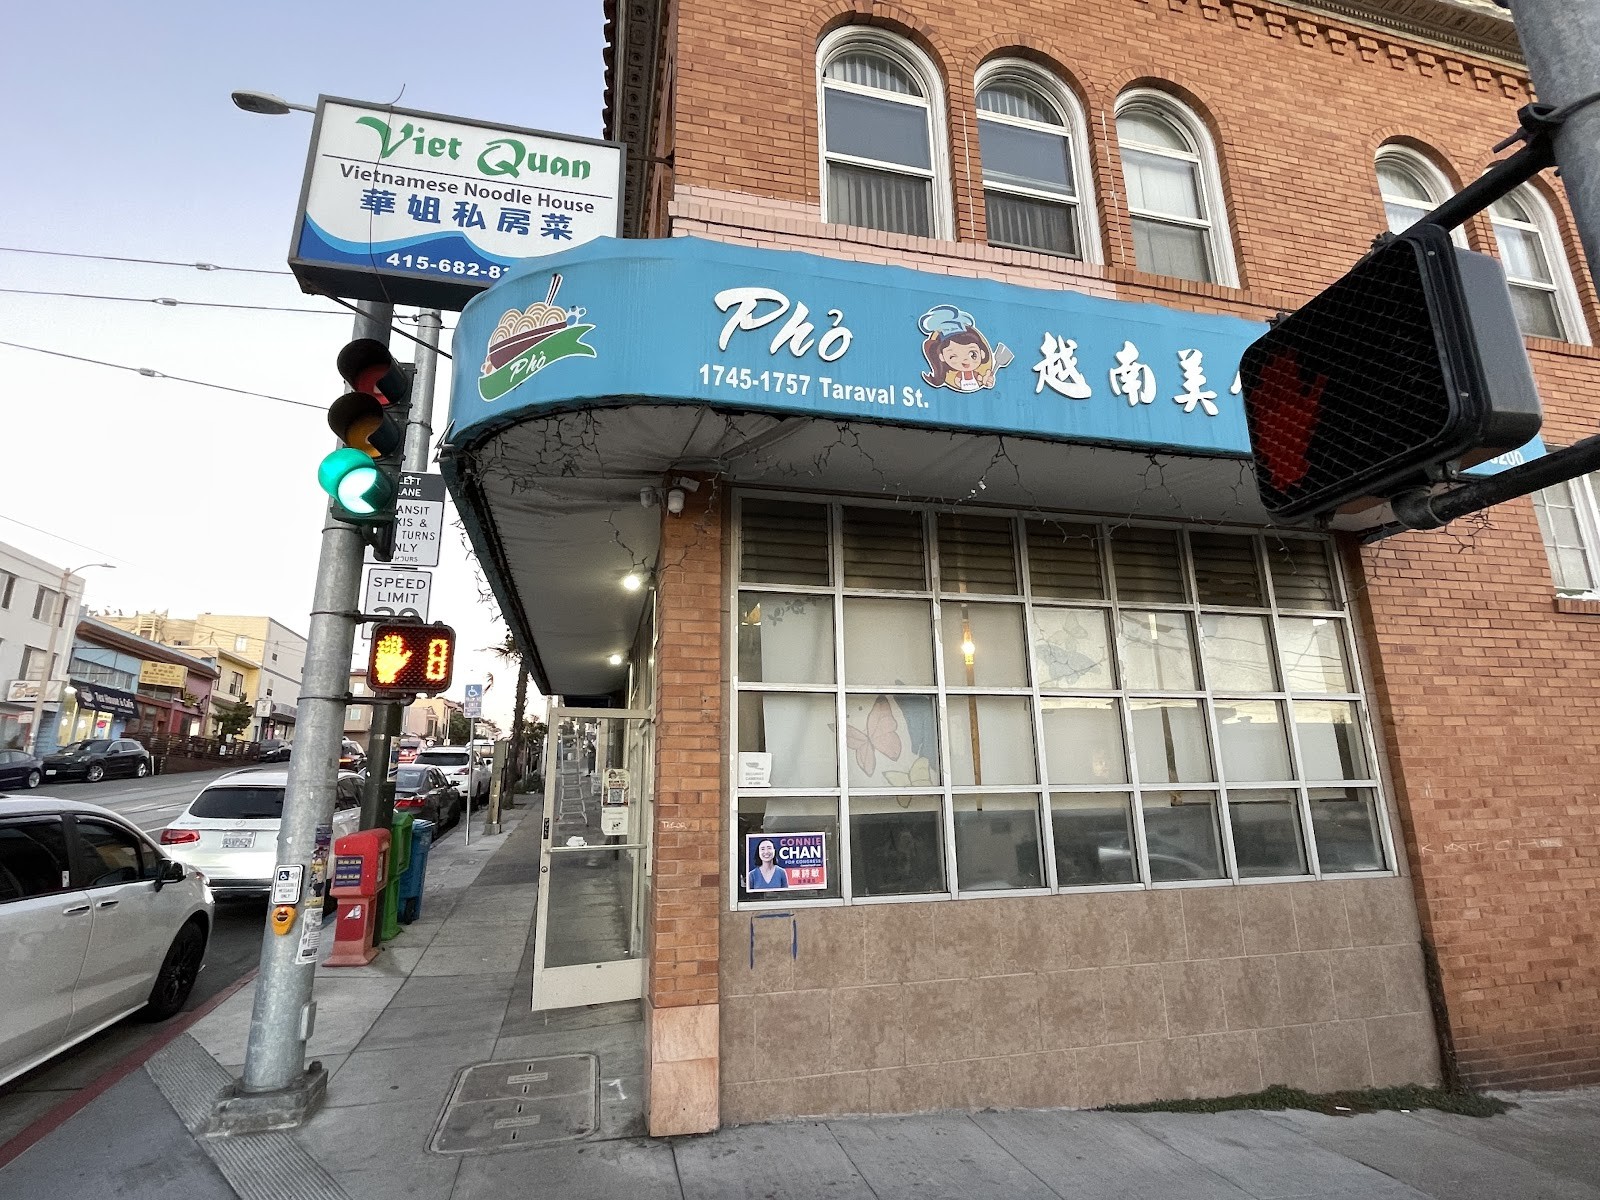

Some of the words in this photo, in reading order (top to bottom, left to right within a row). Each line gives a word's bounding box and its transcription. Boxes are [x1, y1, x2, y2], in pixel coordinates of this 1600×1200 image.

[356, 116, 462, 160] Viet
[477, 138, 591, 181] Quan
[340, 163, 459, 195] Vietnamese
[464, 182, 532, 206] Noodle
[537, 193, 595, 214] House
[359, 188, 573, 241] 華姐私房菜
[386, 252, 510, 280] 415-682-8
[713, 286, 854, 363] Phở
[1033, 331, 1243, 417] 越南美
[699, 363, 811, 397] 1745-1757
[819, 376, 895, 406] Taraval
[901, 387, 930, 409] St.
[398, 488, 421, 497] ANE
[397, 505, 430, 515] ANSIT
[397, 518, 413, 527] XIS
[419, 518, 427, 528] &
[402, 530, 435, 541] TURNS
[395, 543, 418, 553] NLY
[373, 577, 426, 590] SPEED
[377, 591, 419, 604] LIMIT
[780, 837, 822, 847] CONNIE
[779, 846, 821, 860] CHAN
